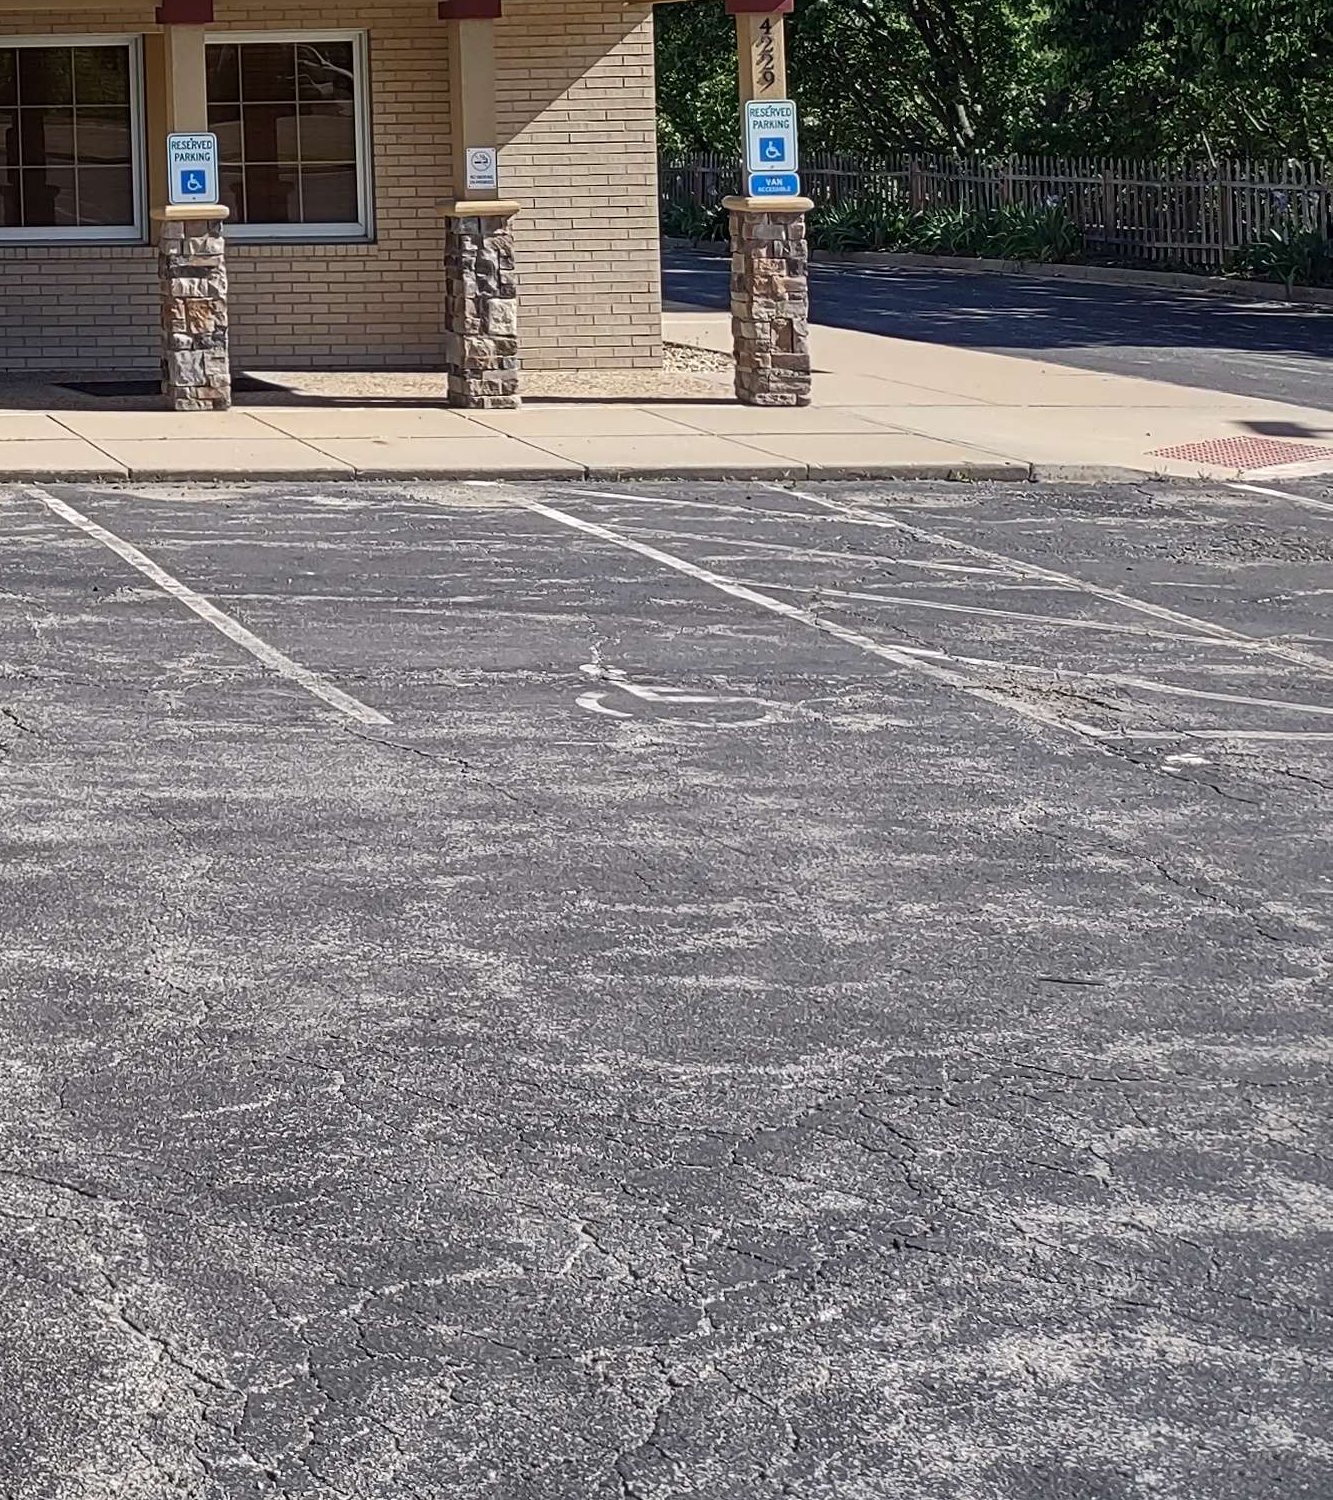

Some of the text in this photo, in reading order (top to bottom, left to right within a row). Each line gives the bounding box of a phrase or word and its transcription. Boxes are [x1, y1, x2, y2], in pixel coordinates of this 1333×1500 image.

[757, 17, 775, 93] 4229
[749, 107, 792, 117] RESERVED
[752, 119, 790, 129] PARKING
[171, 140, 213, 150] RESERVED
[174, 152, 211, 162] PARKING
[765, 178, 783, 186] VAN
